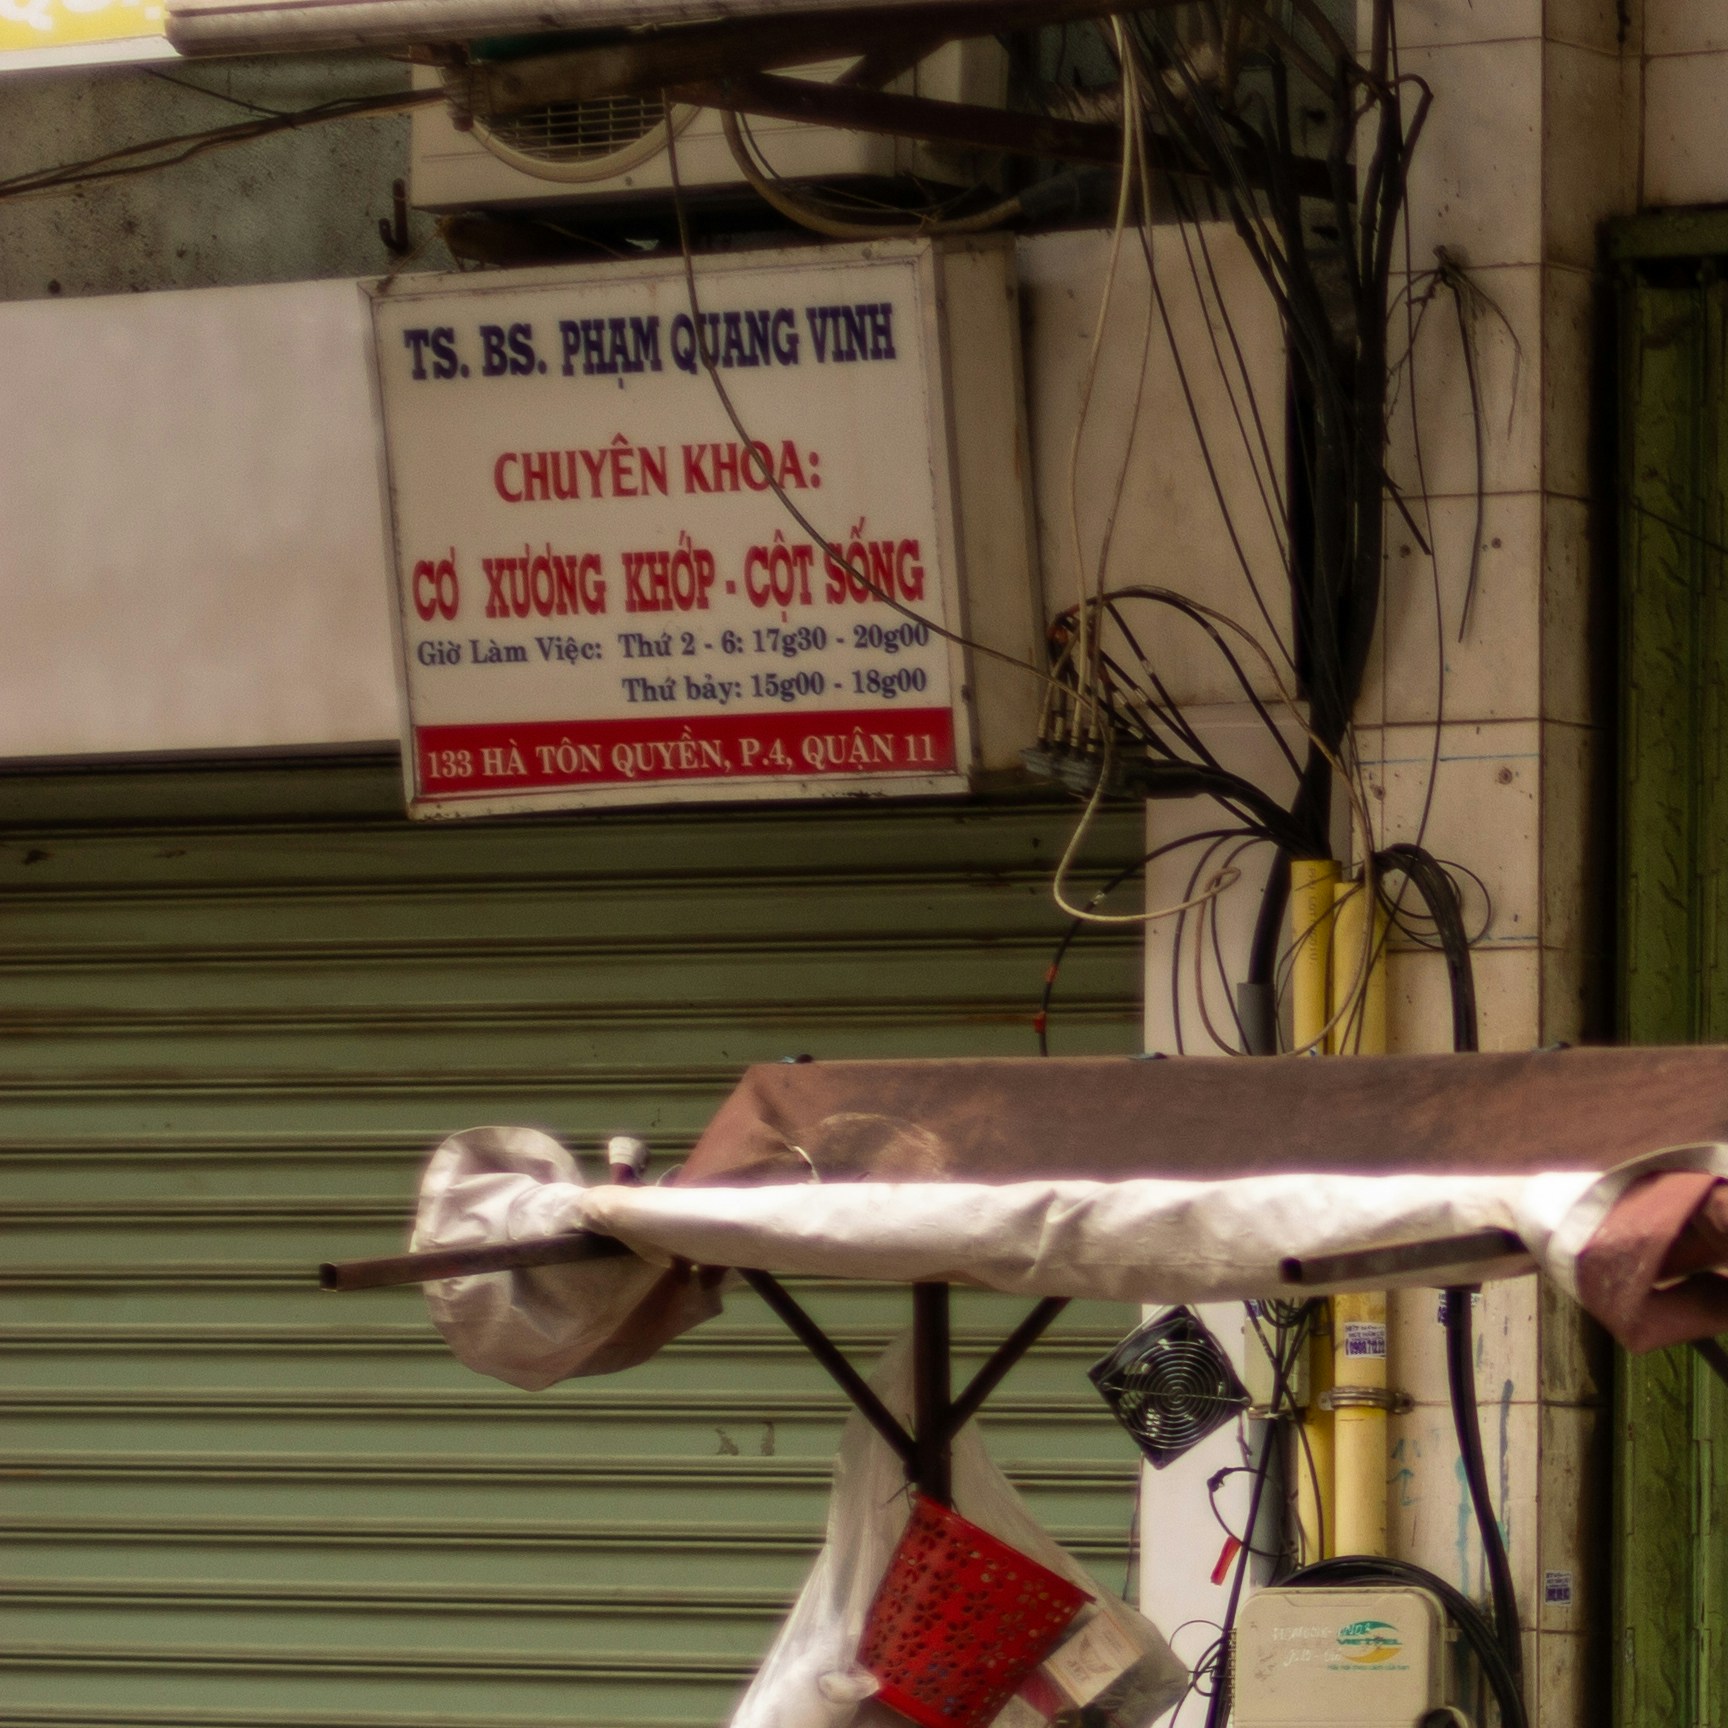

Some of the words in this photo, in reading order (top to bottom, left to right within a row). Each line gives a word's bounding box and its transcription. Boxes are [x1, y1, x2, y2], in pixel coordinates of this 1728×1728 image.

[404, 326, 470, 380] TS.
[480, 322, 548, 378] BS.
[559, 314, 662, 390] PHẠM
[671, 307, 800, 371] QUANG
[806, 301, 897, 363] VINH
[494, 433, 668, 502] CHUYÊN
[683, 439, 823, 494] KHOA:
[412, 546, 460, 621] CƠ
[482, 543, 607, 618] XƯƠNG
[621, 530, 716, 613] KHỚP
[725, 579, 736, 594] -
[744, 529, 814, 622] CỘT
[825, 516, 925, 606] SỐNG
[416, 640, 461, 667] Giờ
[470, 636, 528, 665] Làm
[534, 633, 604, 666] Việc:
[617, 629, 672, 660] Thứ
[680, 631, 696, 657] 2
[722, 628, 744, 655] 6:
[752, 625, 828, 659] 17g30
[852, 620, 931, 654] 20g00
[622, 672, 677, 703] Thứ
[685, 670, 743, 705] bảy:
[750, 669, 826, 703] 15g00
[850, 666, 927, 698] 18g00
[427, 748, 473, 778] 133
[481, 732, 527, 777] HÀ
[535, 736, 602, 774] TÔN
[610, 724, 732, 779] QUYỀN,
[738, 735, 794, 768] P.4,
[801, 725, 895, 770] QUẬN
[904, 732, 935, 762] 11
